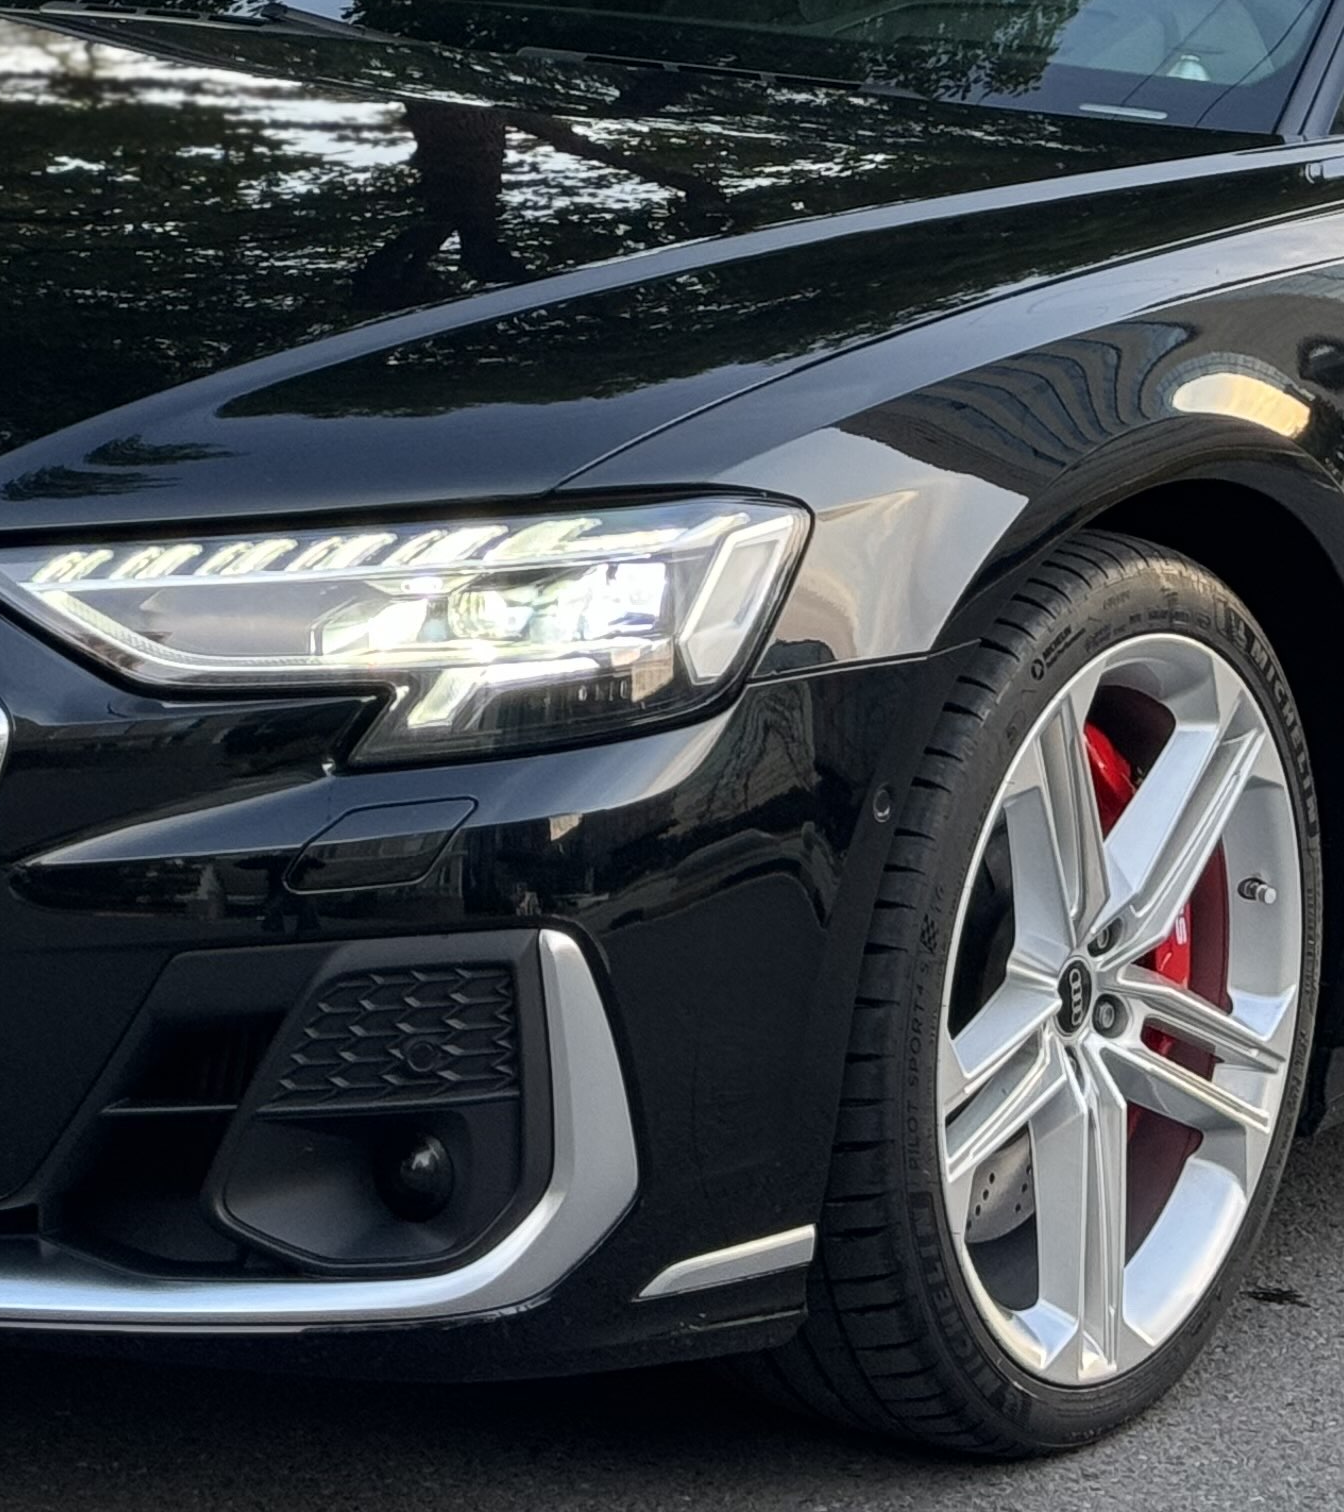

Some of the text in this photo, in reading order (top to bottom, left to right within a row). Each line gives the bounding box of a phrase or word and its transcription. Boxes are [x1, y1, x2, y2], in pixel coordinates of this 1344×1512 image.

[1250, 643, 1317, 823] MICHELIN
[908, 1002, 925, 1086] SPORT
[907, 1099, 921, 1171] PILOT
[910, 1205, 1002, 1400] MICHELIN
